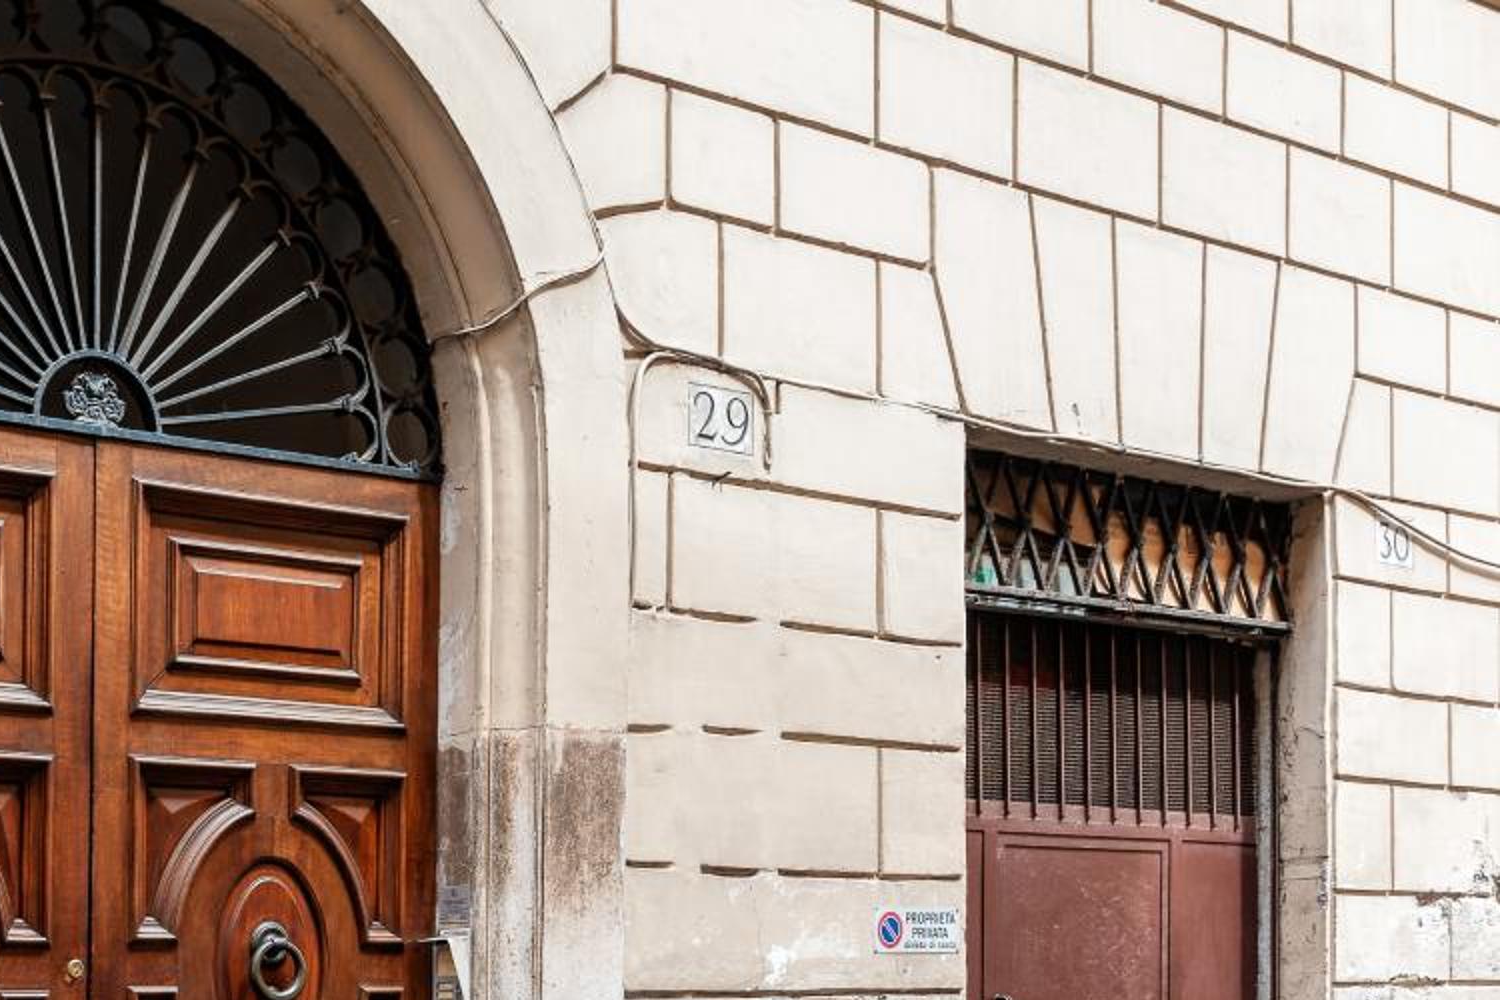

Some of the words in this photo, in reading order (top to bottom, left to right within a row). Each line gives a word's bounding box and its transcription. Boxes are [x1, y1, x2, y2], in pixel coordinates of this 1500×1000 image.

[693, 391, 749, 446] 29
[1379, 521, 1410, 561] 30
[911, 927, 949, 938] PRIVATA
